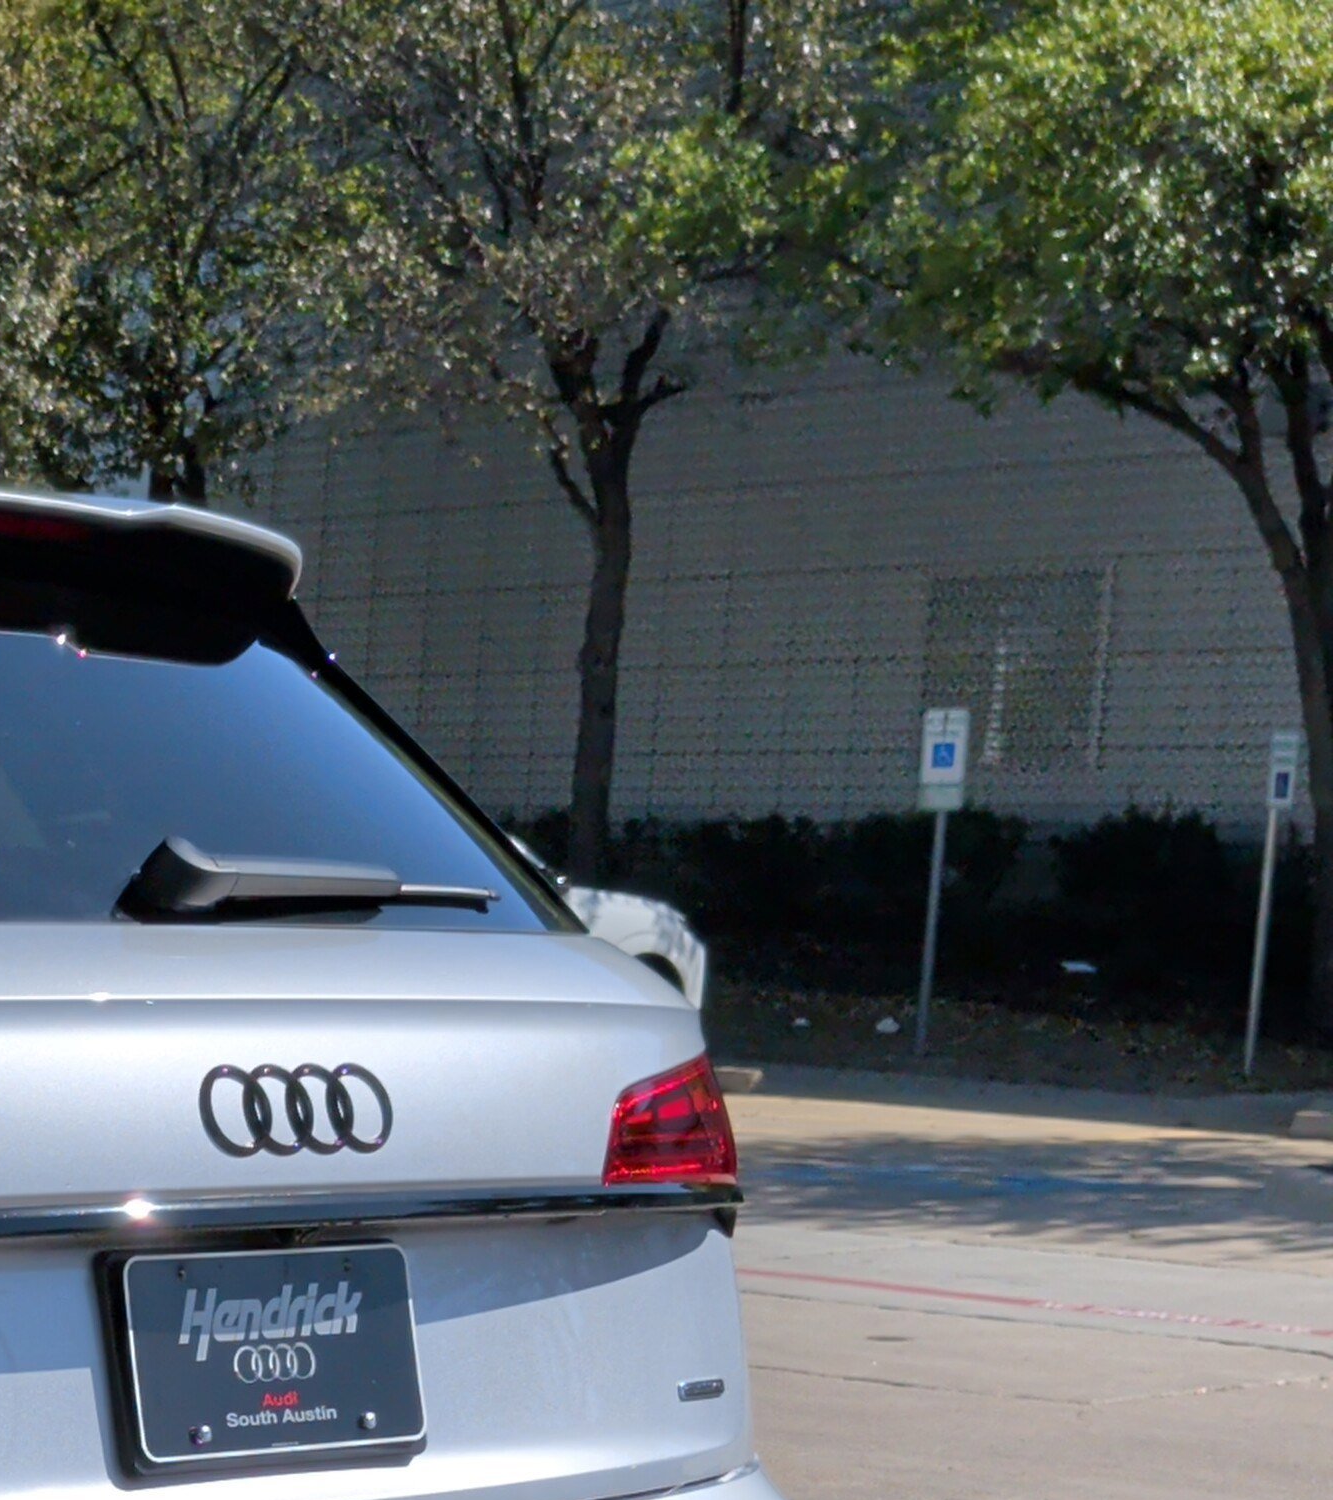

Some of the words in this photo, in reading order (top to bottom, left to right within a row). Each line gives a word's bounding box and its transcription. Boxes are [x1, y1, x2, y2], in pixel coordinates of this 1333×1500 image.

[178, 1281, 362, 1362] Hendrick
[263, 1391, 299, 1407] Audi
[226, 1410, 277, 1428] South
[283, 1405, 337, 1423] Austin
